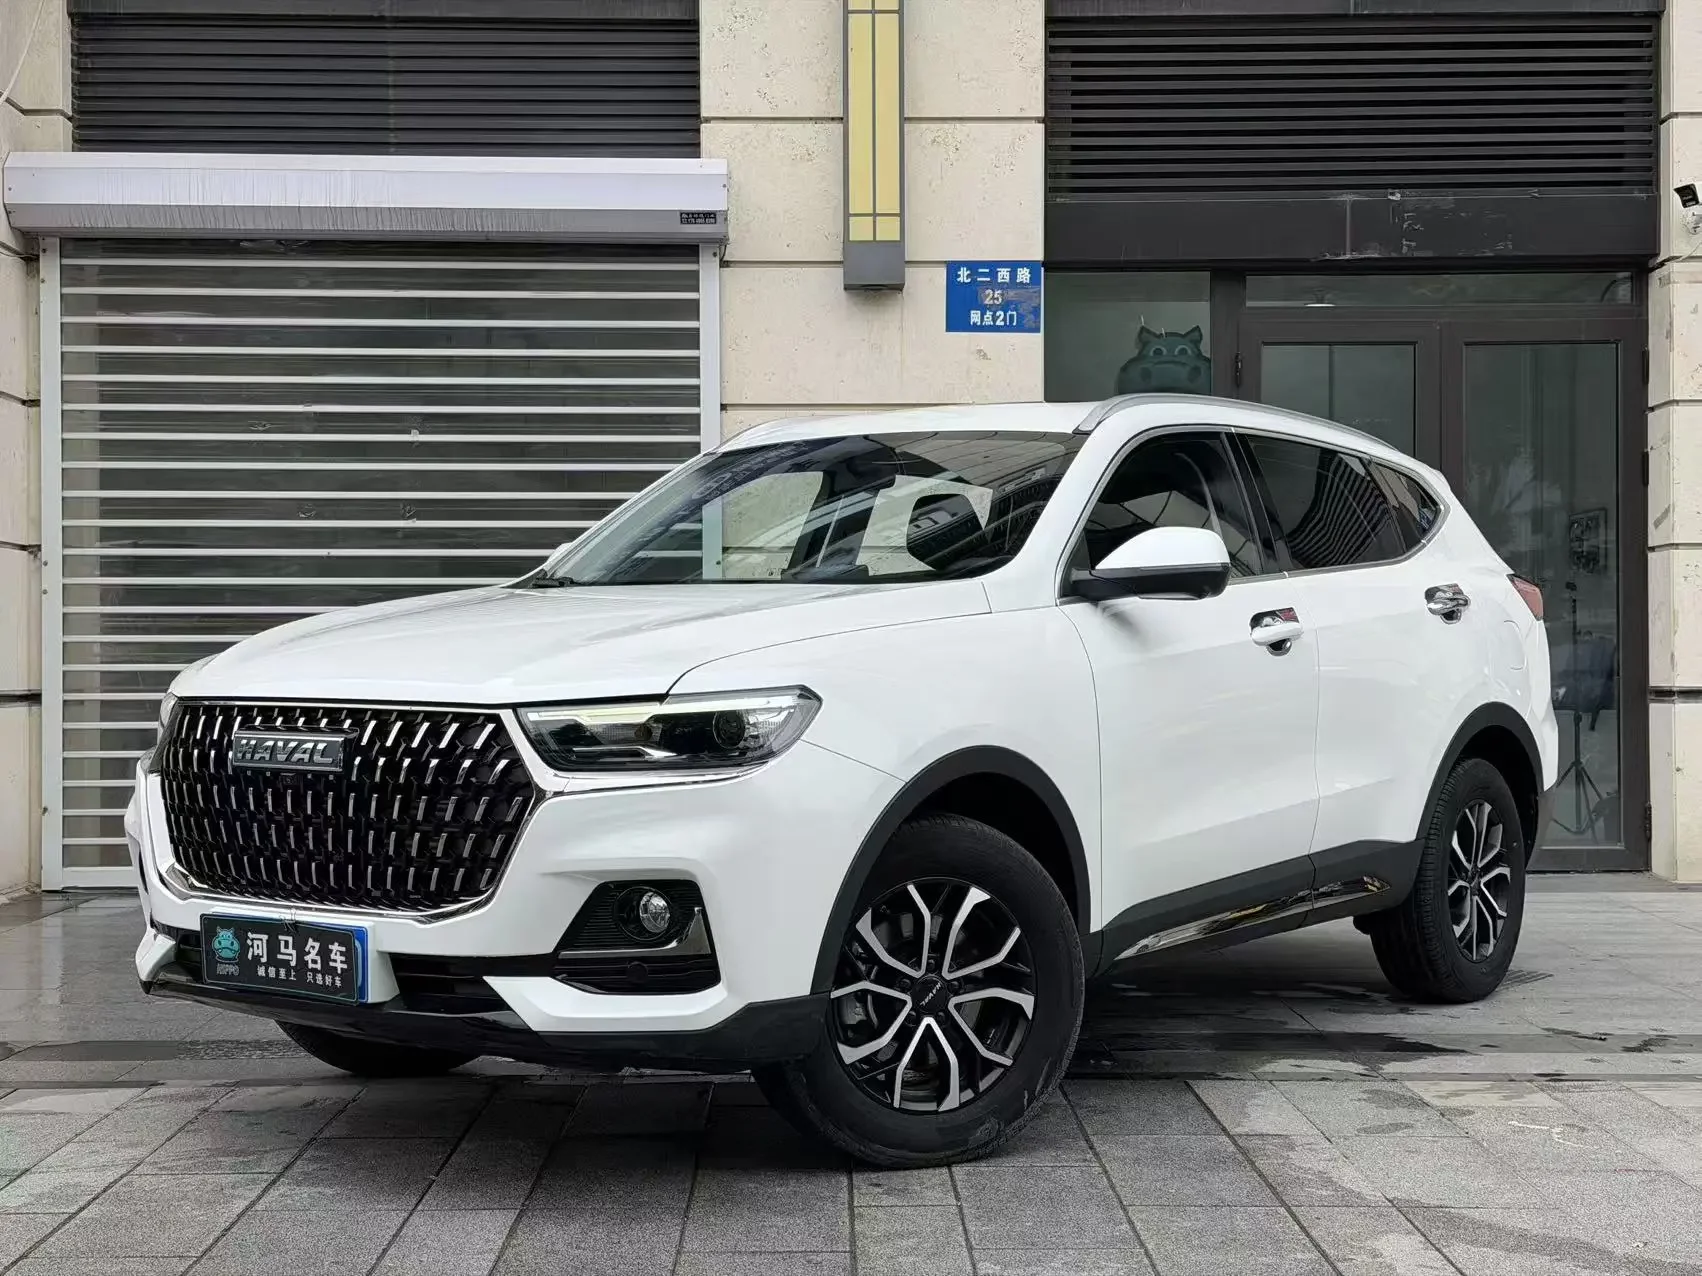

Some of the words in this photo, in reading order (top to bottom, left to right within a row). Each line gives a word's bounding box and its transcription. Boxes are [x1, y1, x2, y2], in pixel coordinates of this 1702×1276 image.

[956, 266, 1032, 284] 北二西路
[984, 289, 1003, 305] 25
[969, 310, 1018, 326] 网点2门
[236, 739, 334, 764] HAVAL
[246, 931, 348, 974] 河马名车
[216, 963, 240, 976] HIPPO
[256, 965, 297, 981] 诚信至上
[306, 971, 342, 988] 只选好车
